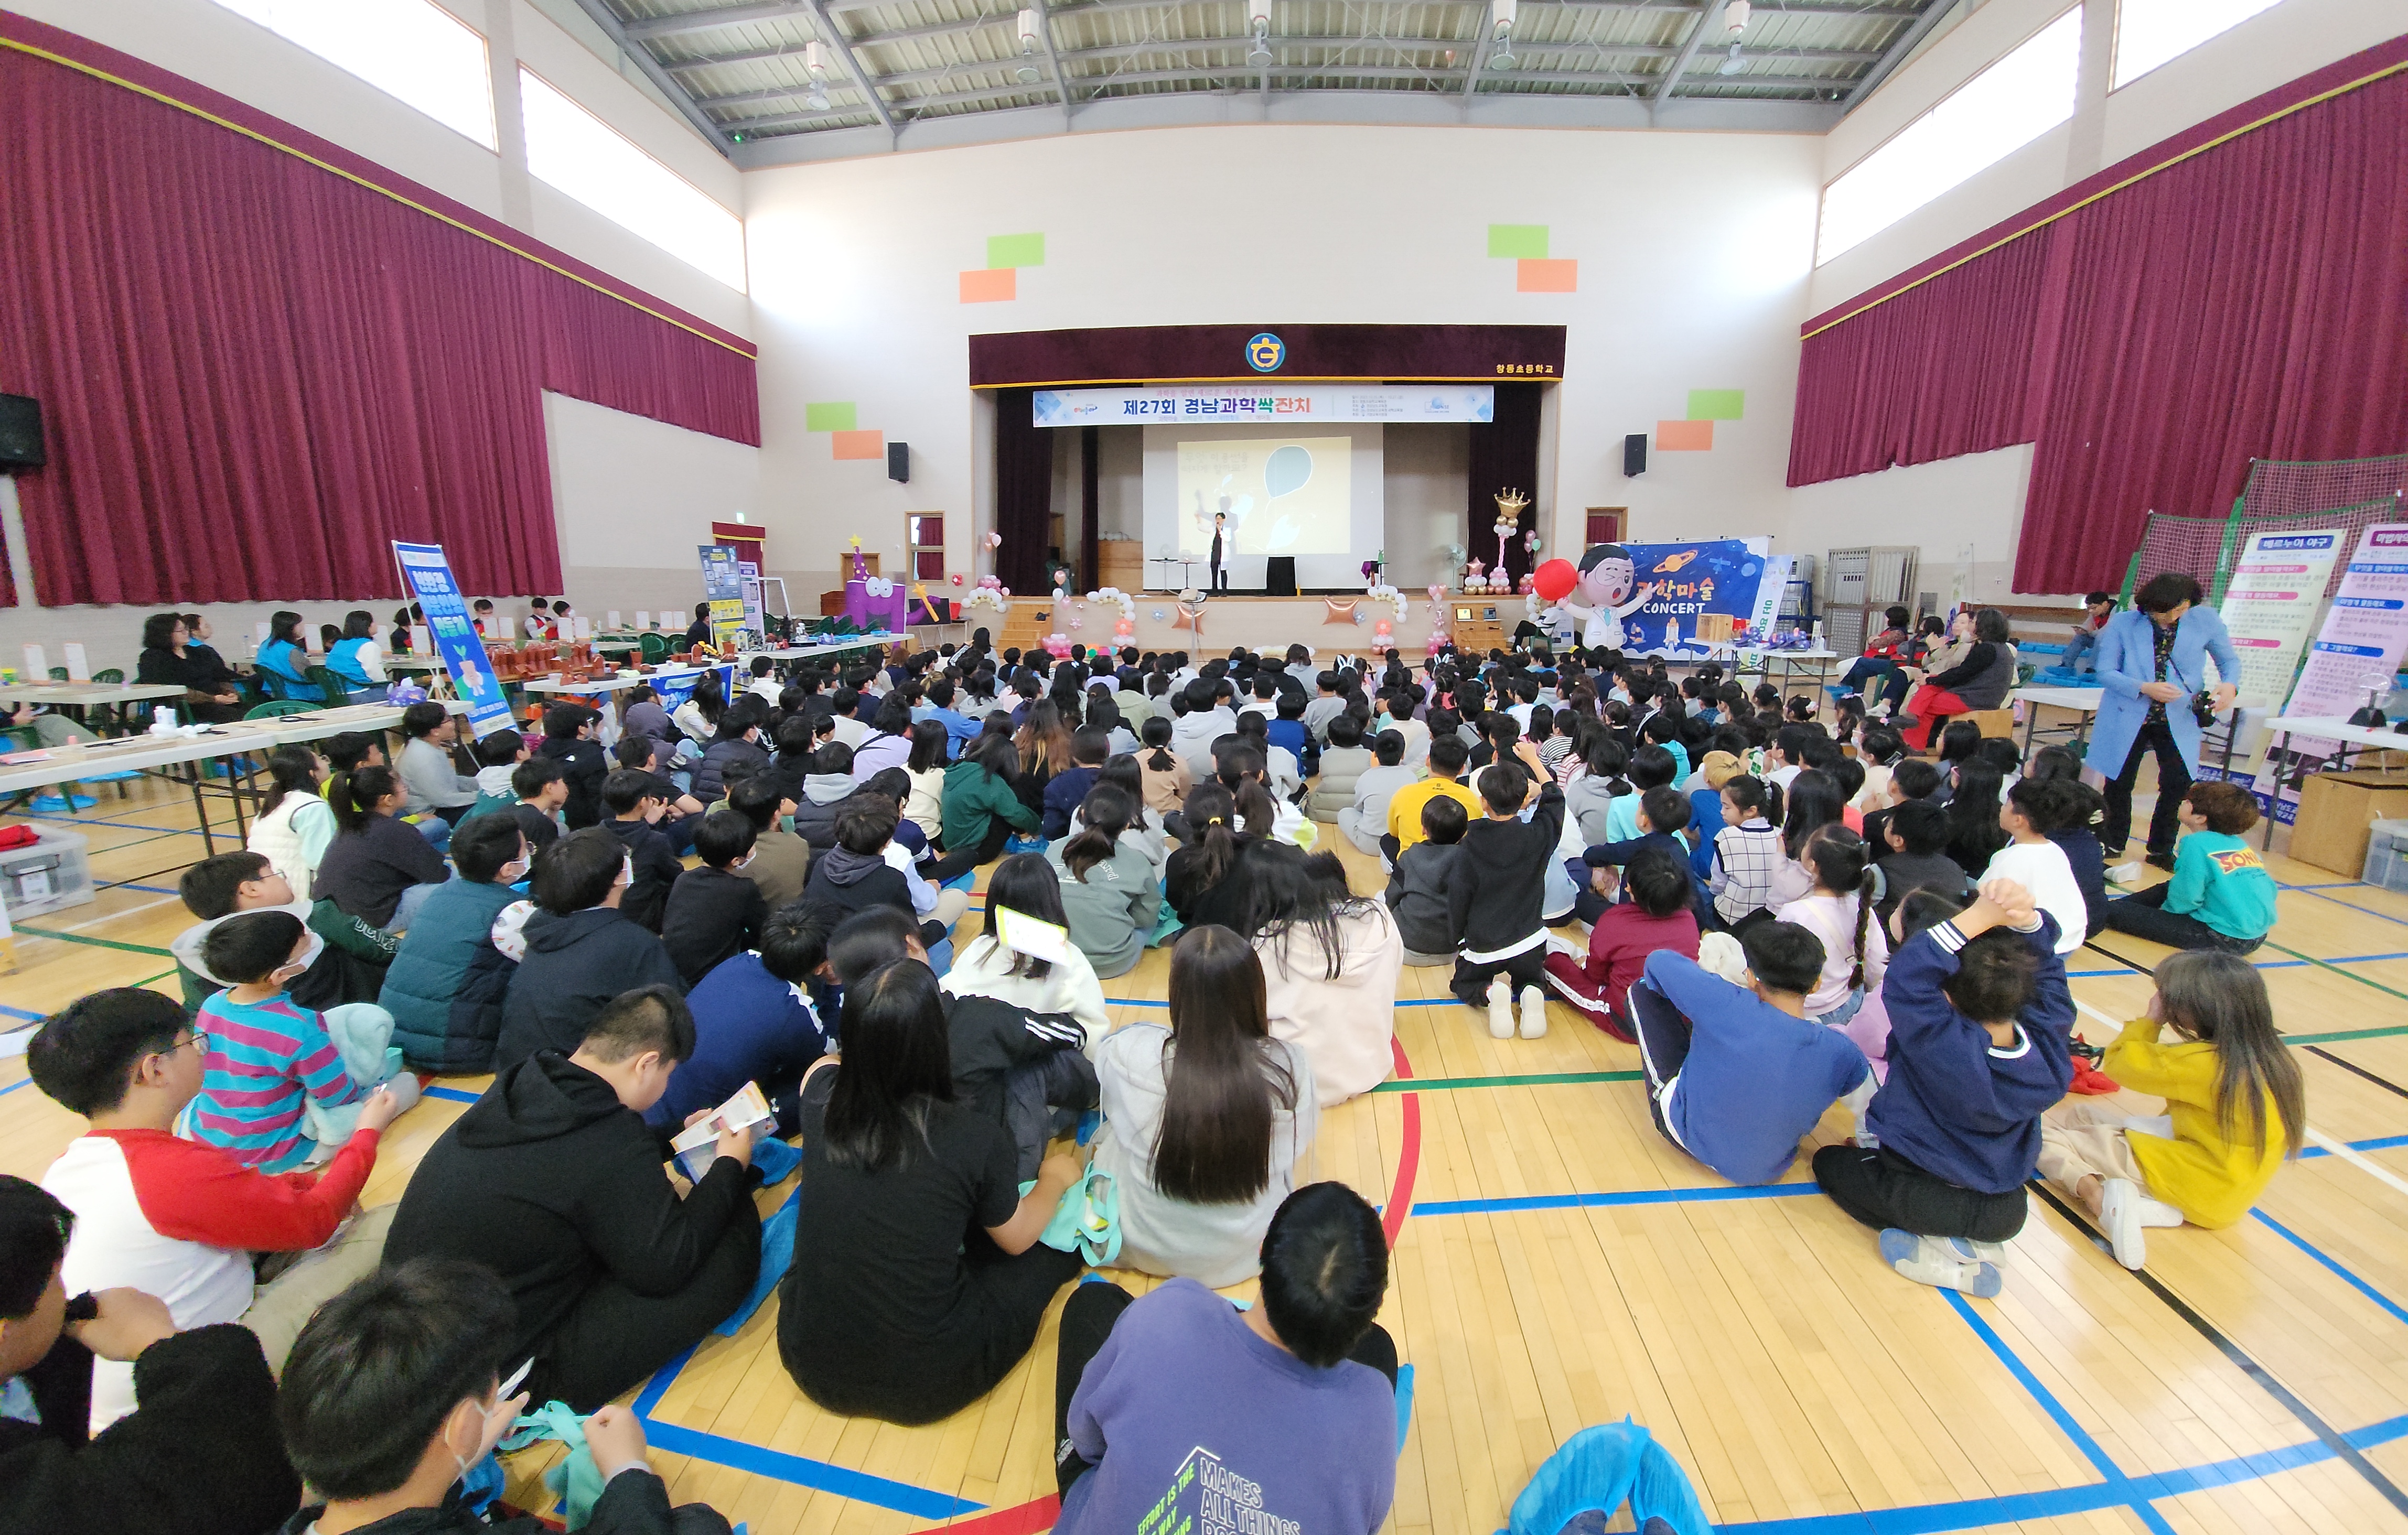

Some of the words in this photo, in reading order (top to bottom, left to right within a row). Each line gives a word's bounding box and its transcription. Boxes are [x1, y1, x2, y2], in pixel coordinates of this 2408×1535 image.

[1496, 364, 1554, 374] 창동초등학교
[1251, 387, 1273, 396] 보인다
[1123, 398, 1176, 416] 제27회
[1184, 397, 1313, 415] 경남과학싹잔치
[2306, 537, 2328, 548] 야구
[412, 570, 451, 593] 친환경
[1642, 602, 1706, 614] CONCERT
[1748, 599, 1773, 667] 운영부
[1200, 1457, 1263, 1509] MAKES
[1137, 1497, 1166, 1535] EFFORT
[1167, 1485, 1177, 1506] IS
[1178, 1462, 1195, 1493] THE
[1200, 1488, 1236, 1529] ALL
[1158, 1505, 1178, 1535] WAY
